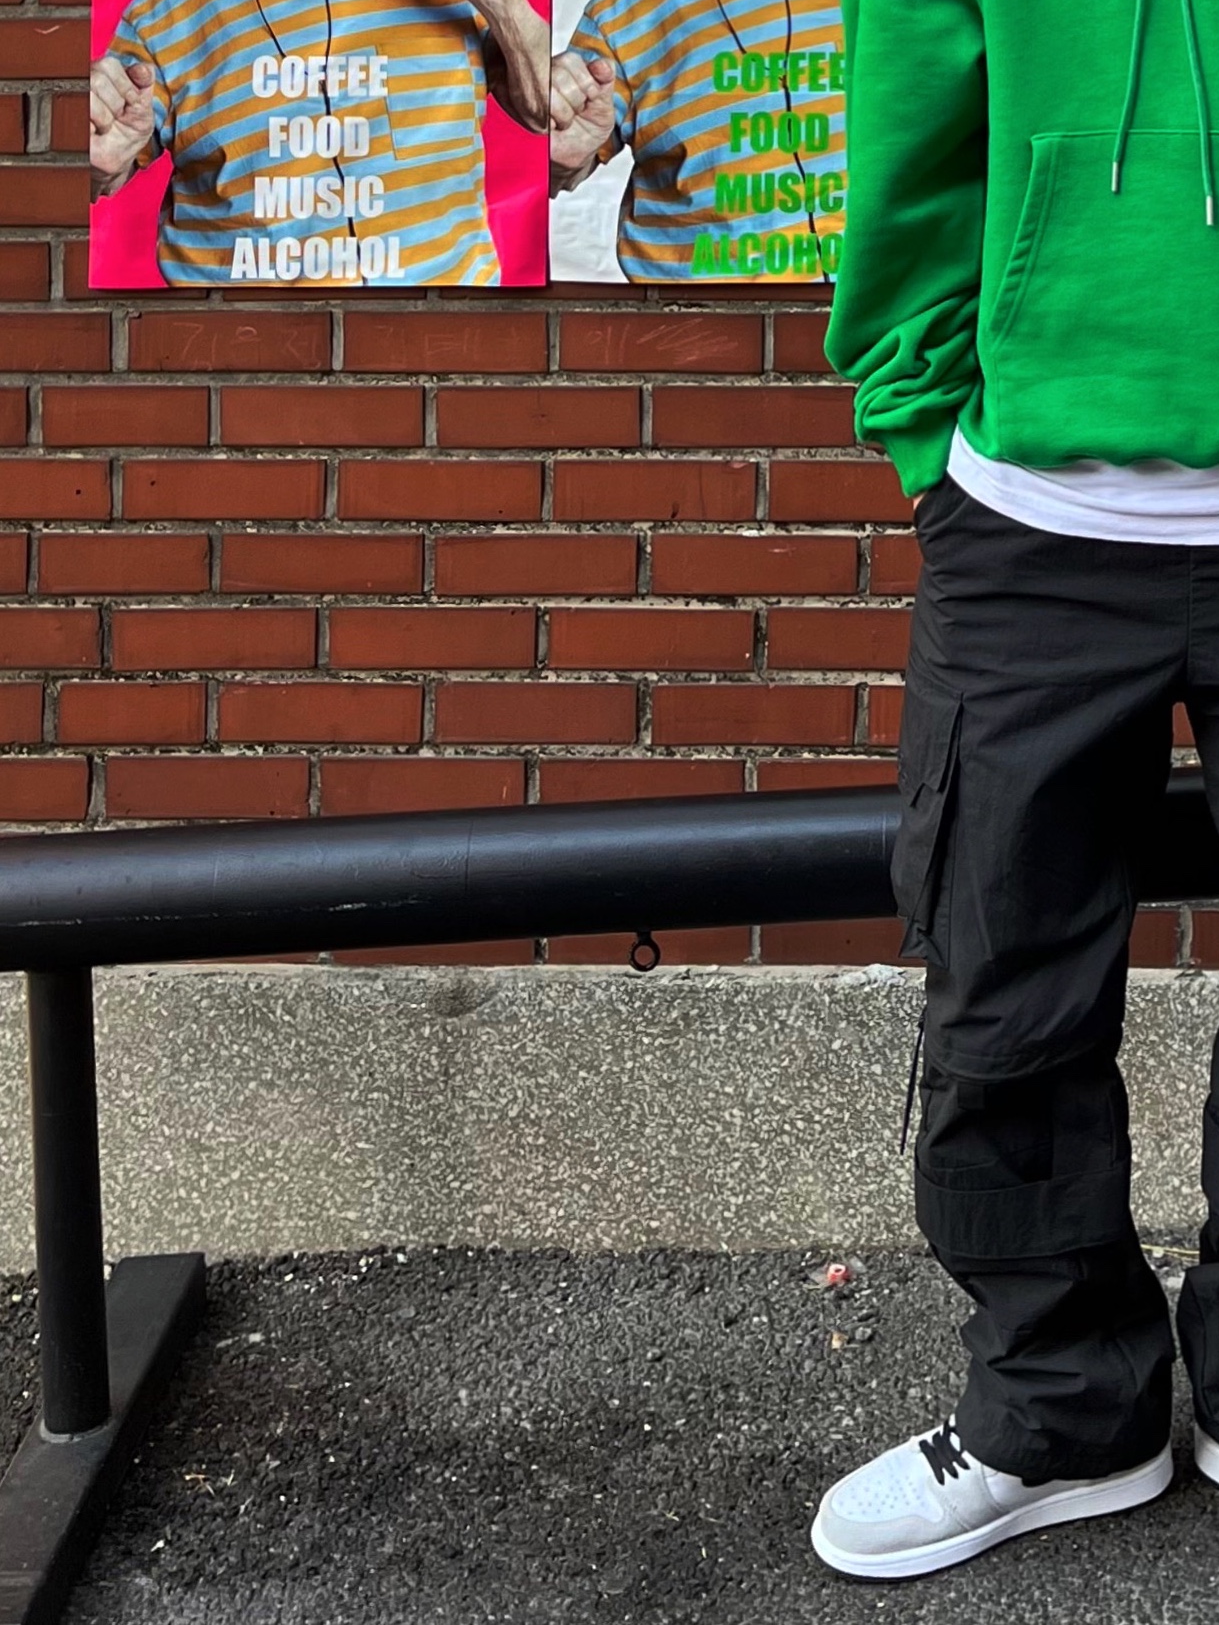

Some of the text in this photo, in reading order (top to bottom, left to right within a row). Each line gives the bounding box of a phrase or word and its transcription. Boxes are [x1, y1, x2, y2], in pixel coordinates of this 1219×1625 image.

[251, 54, 389, 99] COFFEE
[712, 51, 846, 93] COFFEE
[268, 116, 370, 159] FOOD
[730, 111, 830, 154] FOOD
[253, 175, 385, 219] MUSIC
[714, 172, 845, 215] MUSIC
[230, 235, 406, 280] ALCOHOL
[689, 232, 843, 276] ALCOHO
